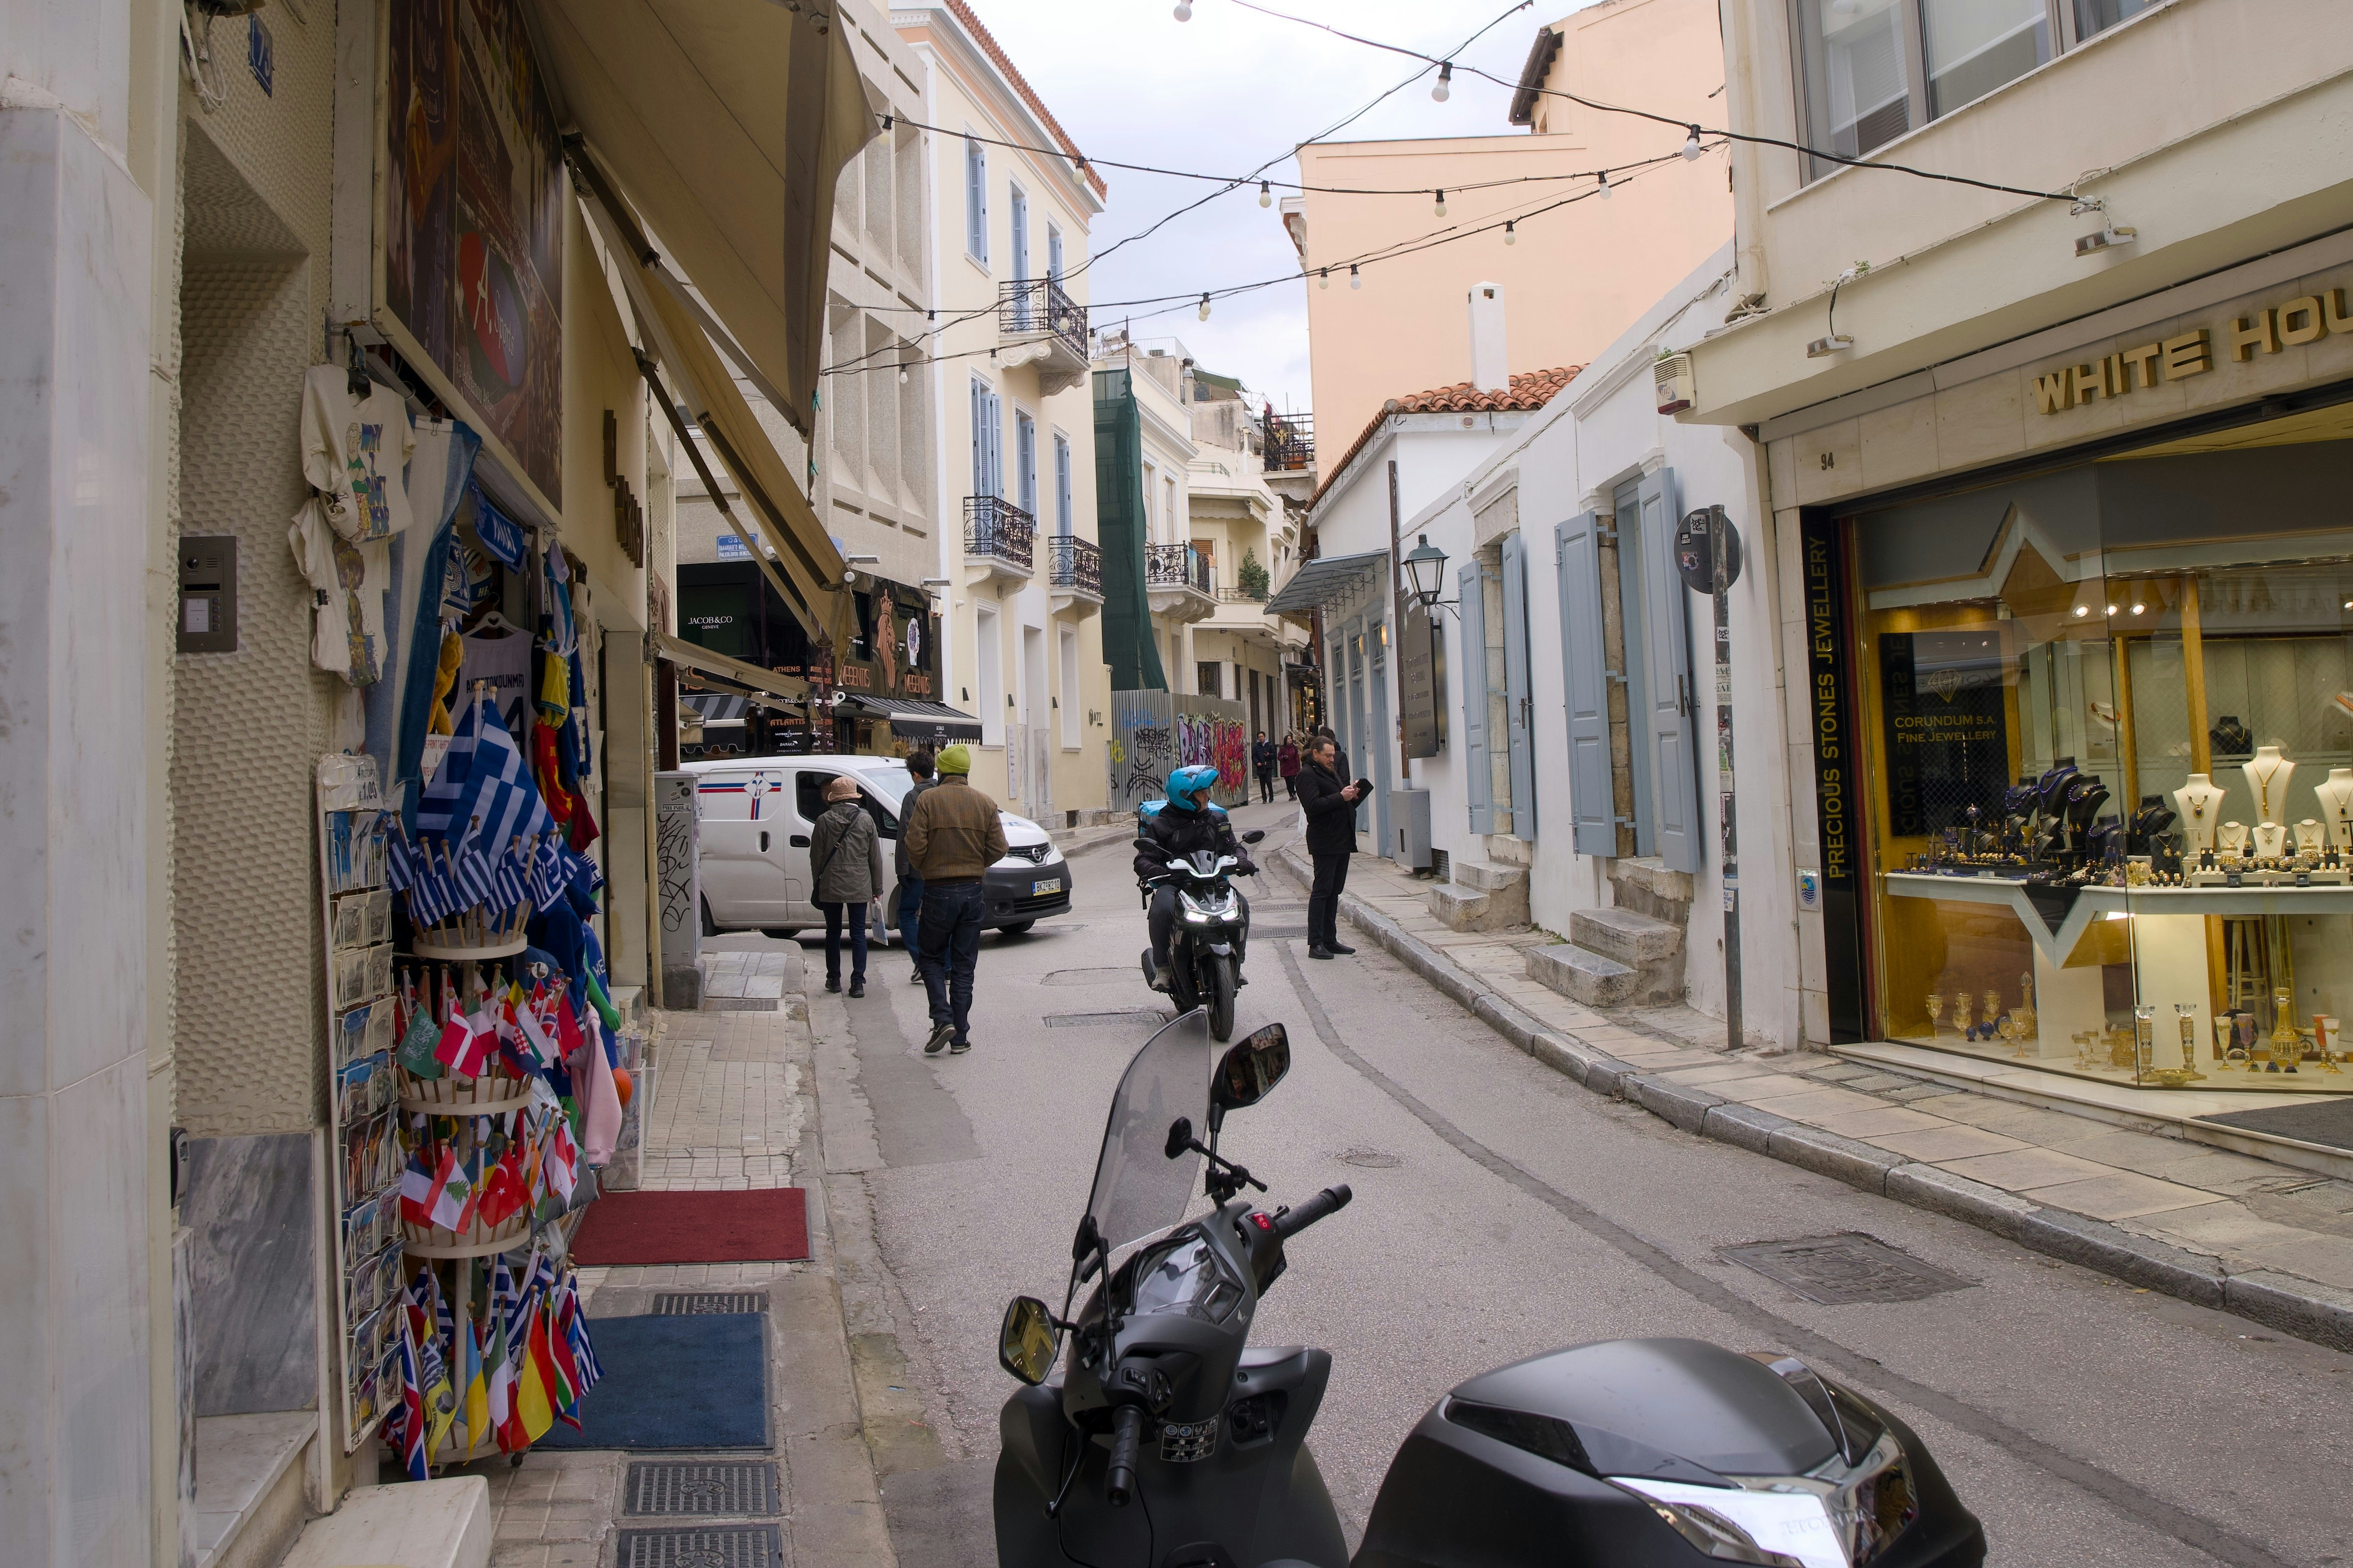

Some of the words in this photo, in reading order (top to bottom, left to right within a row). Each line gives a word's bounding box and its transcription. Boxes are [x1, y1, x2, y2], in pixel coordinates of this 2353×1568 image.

[495, 289, 515, 357] Sports
[456, 351, 462, 378] 73
[482, 386, 497, 421] Athens
[2032, 329, 2213, 415] WHITE
[1821, 452, 1834, 471] 94
[688, 616, 733, 624] JACOB&CO
[1809, 536, 1833, 664] JEWELLERY
[770, 718, 806, 727] ATLANTIS
[1819, 674, 1838, 759] STONES
[1894, 715, 1973, 728] CORUNDUM
[1976, 715, 1997, 725] S.A.
[1823, 769, 1845, 879] PRECIOUS
